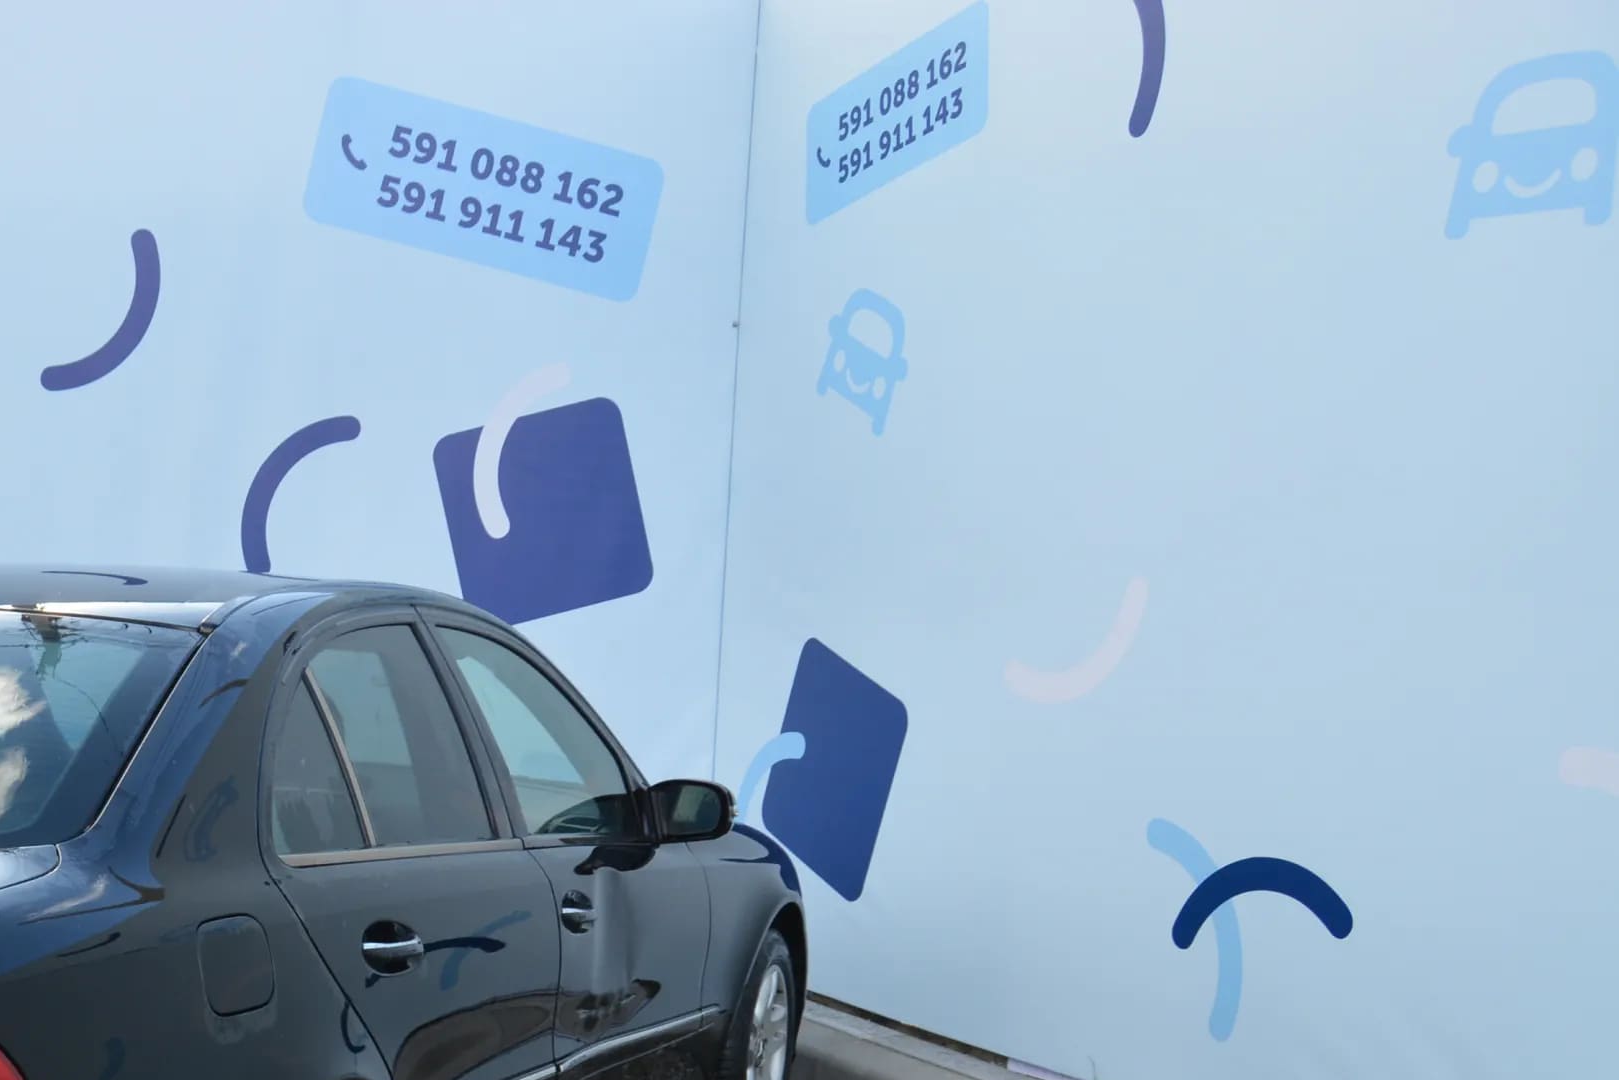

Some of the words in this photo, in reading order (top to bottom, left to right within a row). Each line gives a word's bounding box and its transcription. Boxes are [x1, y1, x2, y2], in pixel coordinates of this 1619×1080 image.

[838, 98, 874, 141] 591
[879, 70, 919, 116] 088
[926, 41, 967, 90] 162
[838, 141, 873, 184] 591
[879, 115, 916, 160] 911
[922, 87, 963, 136] 143
[388, 125, 457, 172] 591
[470, 148, 545, 194] 088
[553, 171, 624, 217] 162
[376, 174, 445, 222] 591
[458, 196, 525, 243] 911
[535, 218, 608, 263] 143
